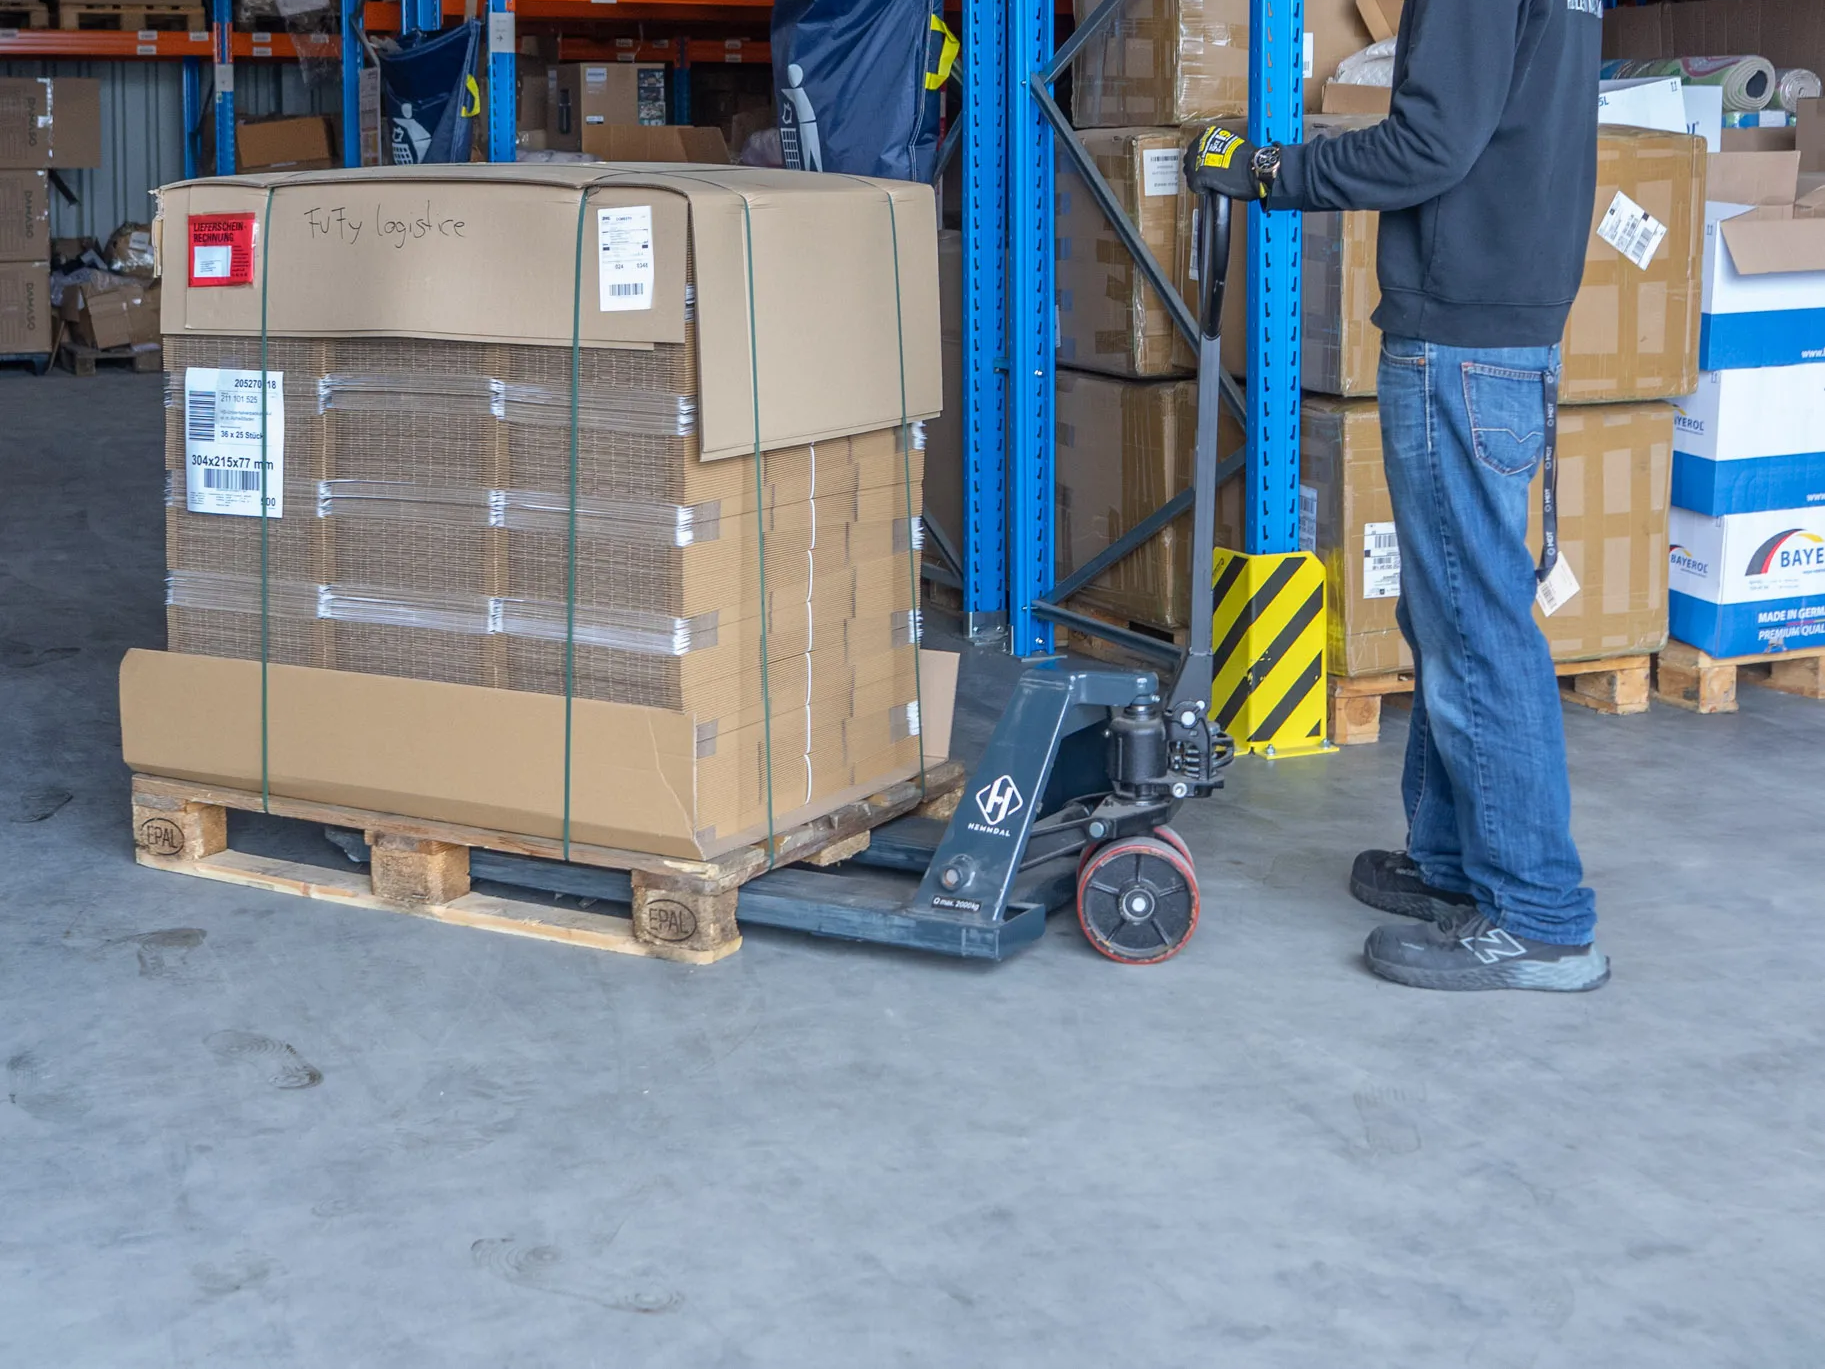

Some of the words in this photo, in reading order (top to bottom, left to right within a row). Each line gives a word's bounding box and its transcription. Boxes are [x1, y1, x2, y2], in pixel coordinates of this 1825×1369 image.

[193, 233, 234, 243] RECHNUNG
[234, 378, 277, 390] 20527018
[220, 430, 229, 439] 36
[235, 431, 244, 439] 25
[191, 454, 251, 470] 304x215x77
[1758, 610, 1786, 624] MADE
[1786, 608, 1797, 620] IN
[1798, 606, 1825, 620] GERM
[1757, 625, 1800, 641] PREMIUM
[147, 825, 179, 849] EPAL
[648, 907, 690, 936] EPAL
